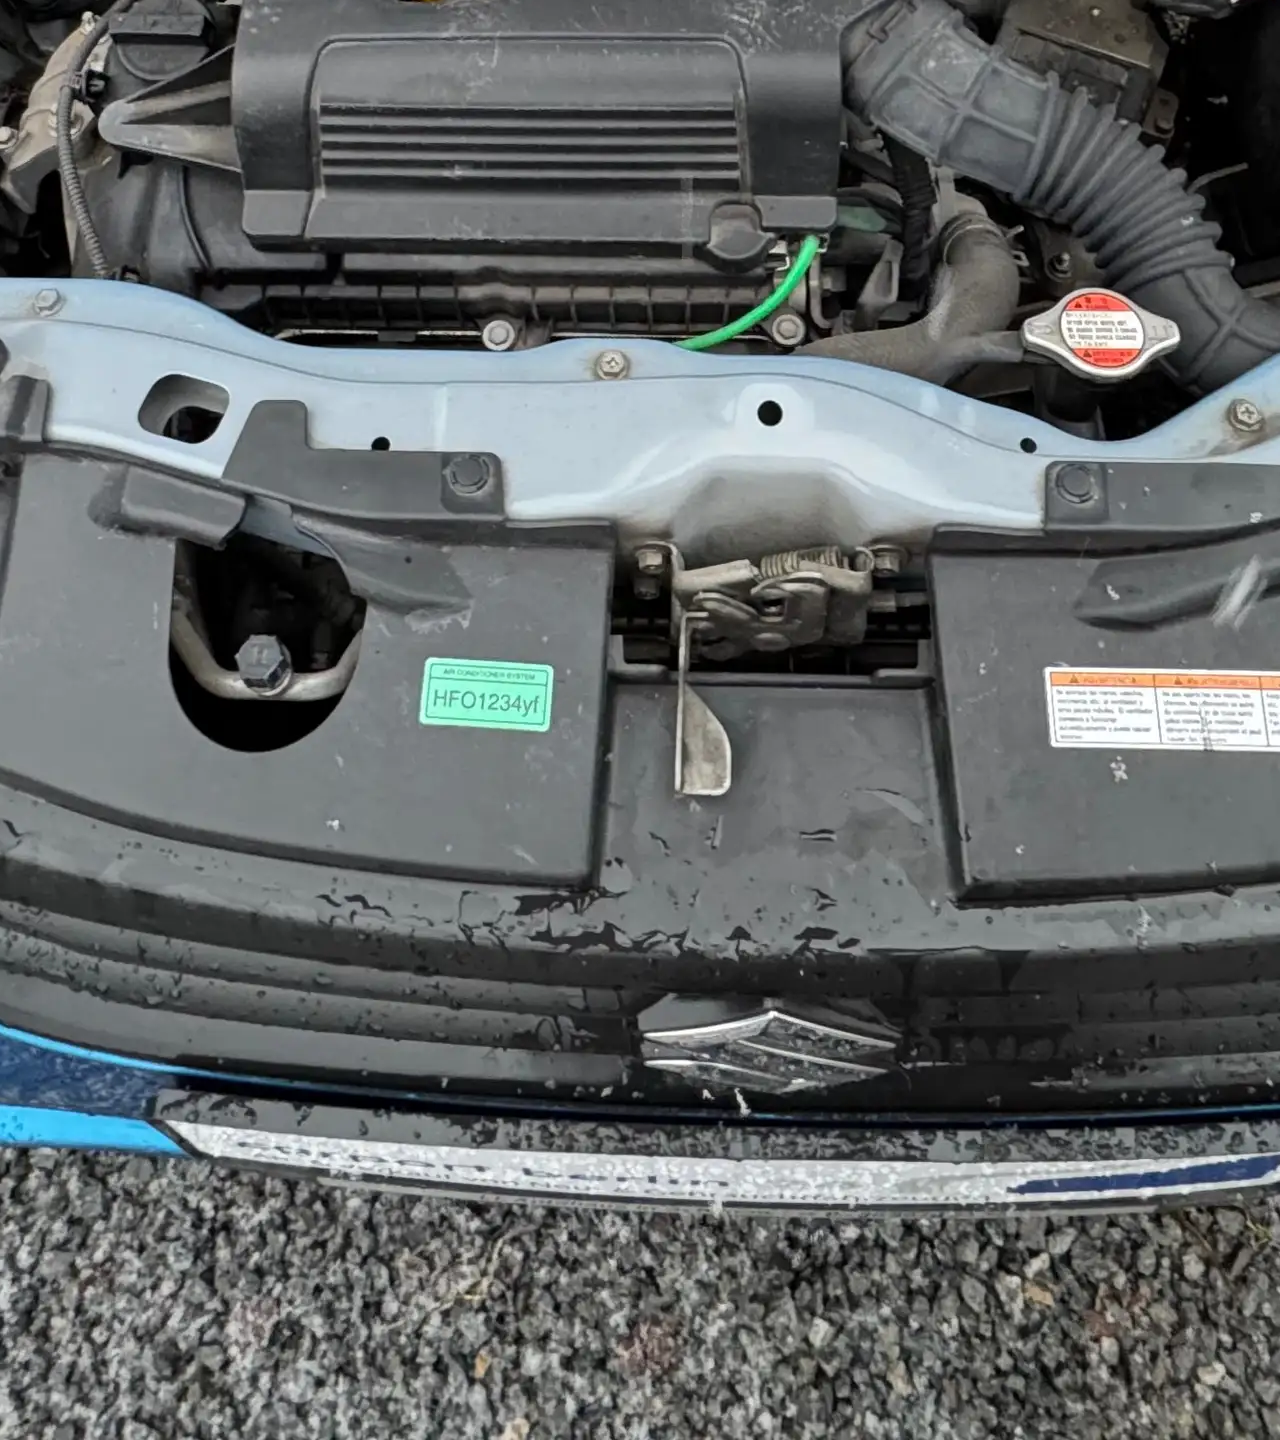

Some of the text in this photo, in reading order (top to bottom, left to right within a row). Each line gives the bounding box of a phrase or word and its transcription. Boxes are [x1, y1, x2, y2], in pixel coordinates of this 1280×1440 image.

[457, 669, 505, 678] CONDITIONER
[506, 672, 536, 680] SYSTEM
[433, 690, 540, 717] HFO1234yf
